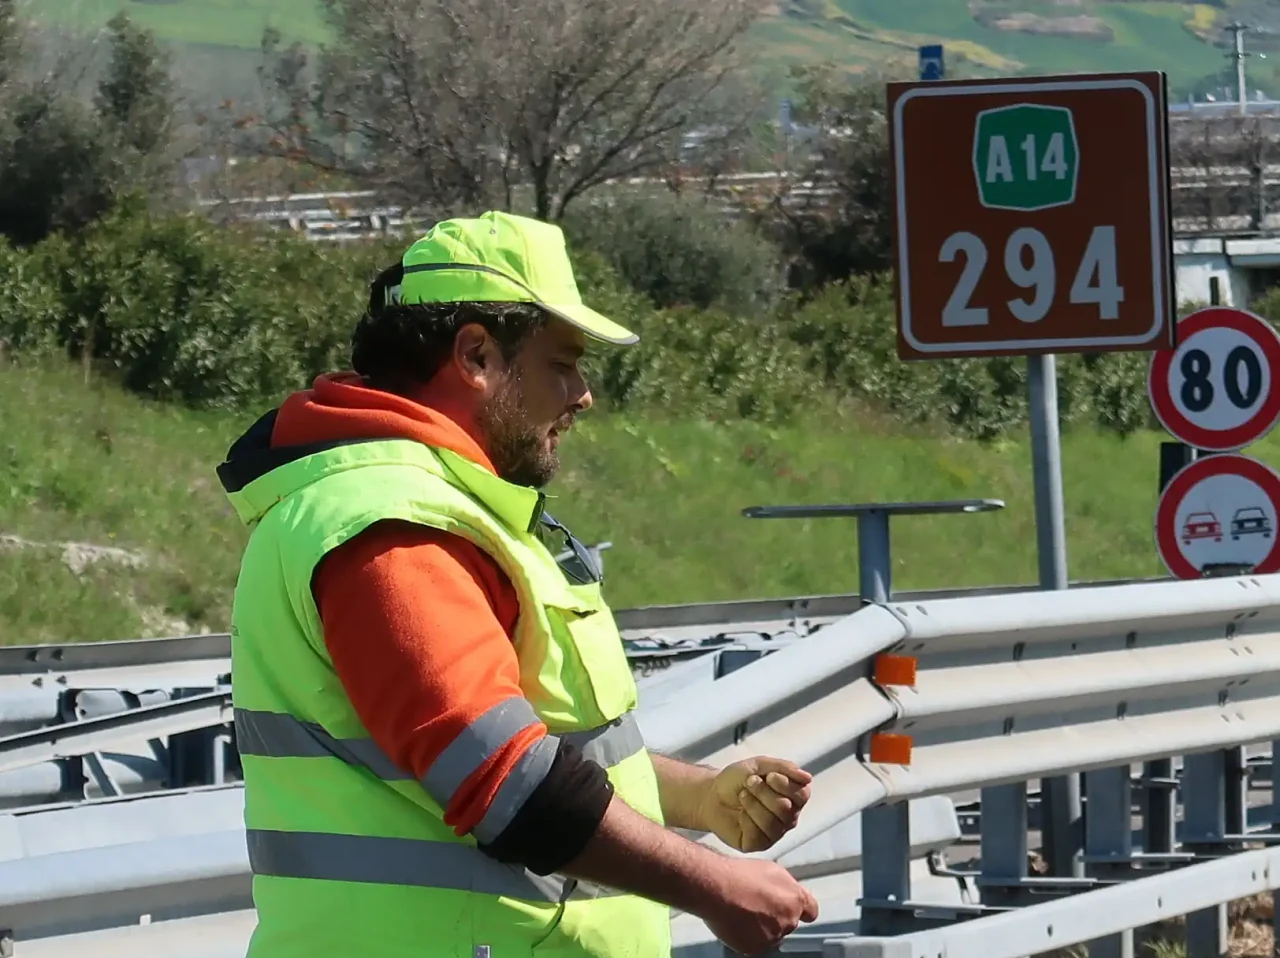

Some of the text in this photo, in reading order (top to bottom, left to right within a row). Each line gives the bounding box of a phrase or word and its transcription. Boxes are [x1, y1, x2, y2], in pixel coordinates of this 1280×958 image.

[985, 132, 1068, 183] A14
[937, 225, 1125, 328] 294
[1180, 345, 1262, 413] 80
